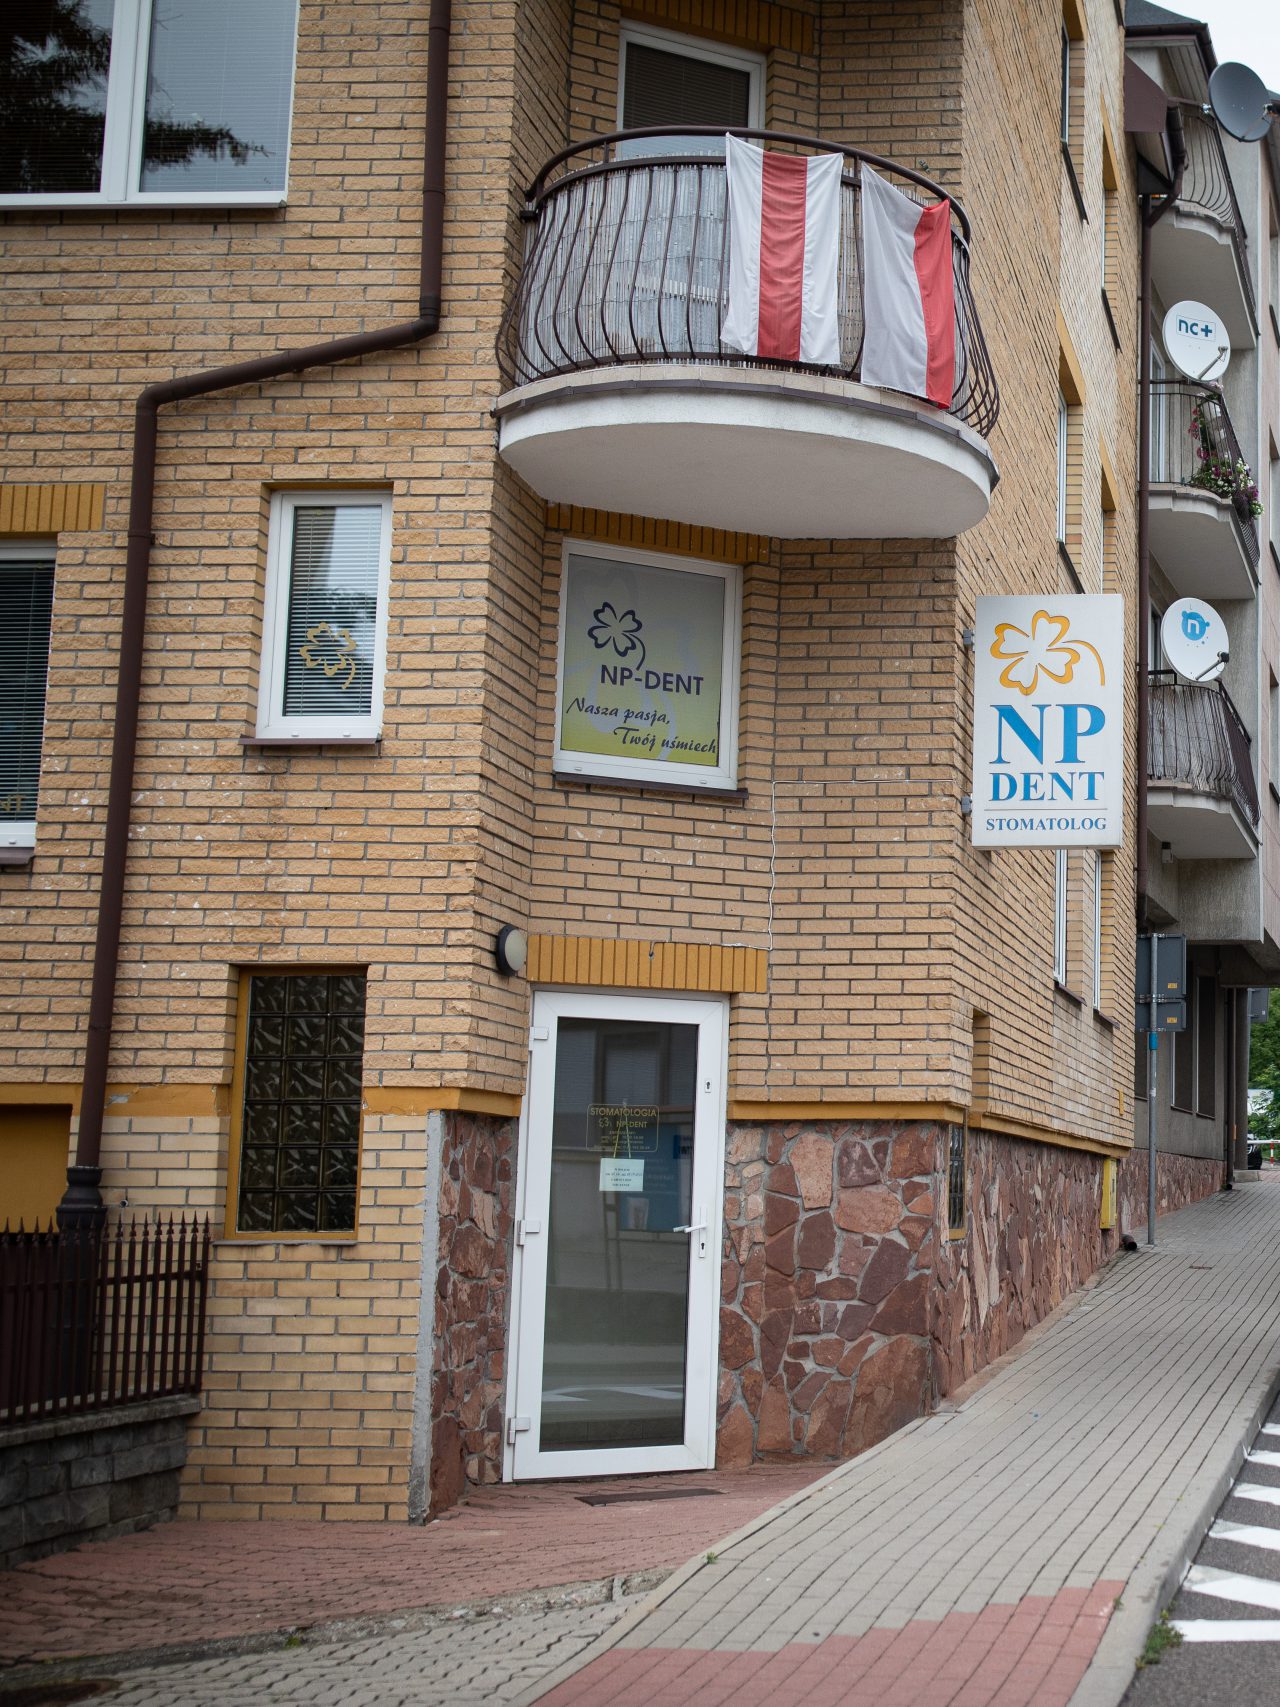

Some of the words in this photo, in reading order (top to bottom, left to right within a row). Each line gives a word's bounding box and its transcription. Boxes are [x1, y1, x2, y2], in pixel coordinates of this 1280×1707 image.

[1178, 319, 1213, 337] nc+
[600, 664, 704, 696] NP-DENT
[566, 697, 619, 717] Nasza
[624, 708, 670, 725] pasja,
[613, 726, 656, 751] Twój
[661, 735, 716, 754] uśmiech
[988, 703, 1106, 765] NP
[988, 771, 1105, 802] DENT
[986, 817, 1107, 831] STOMATOLOG
[590, 1107, 657, 1117] STOMATOLOGIA
